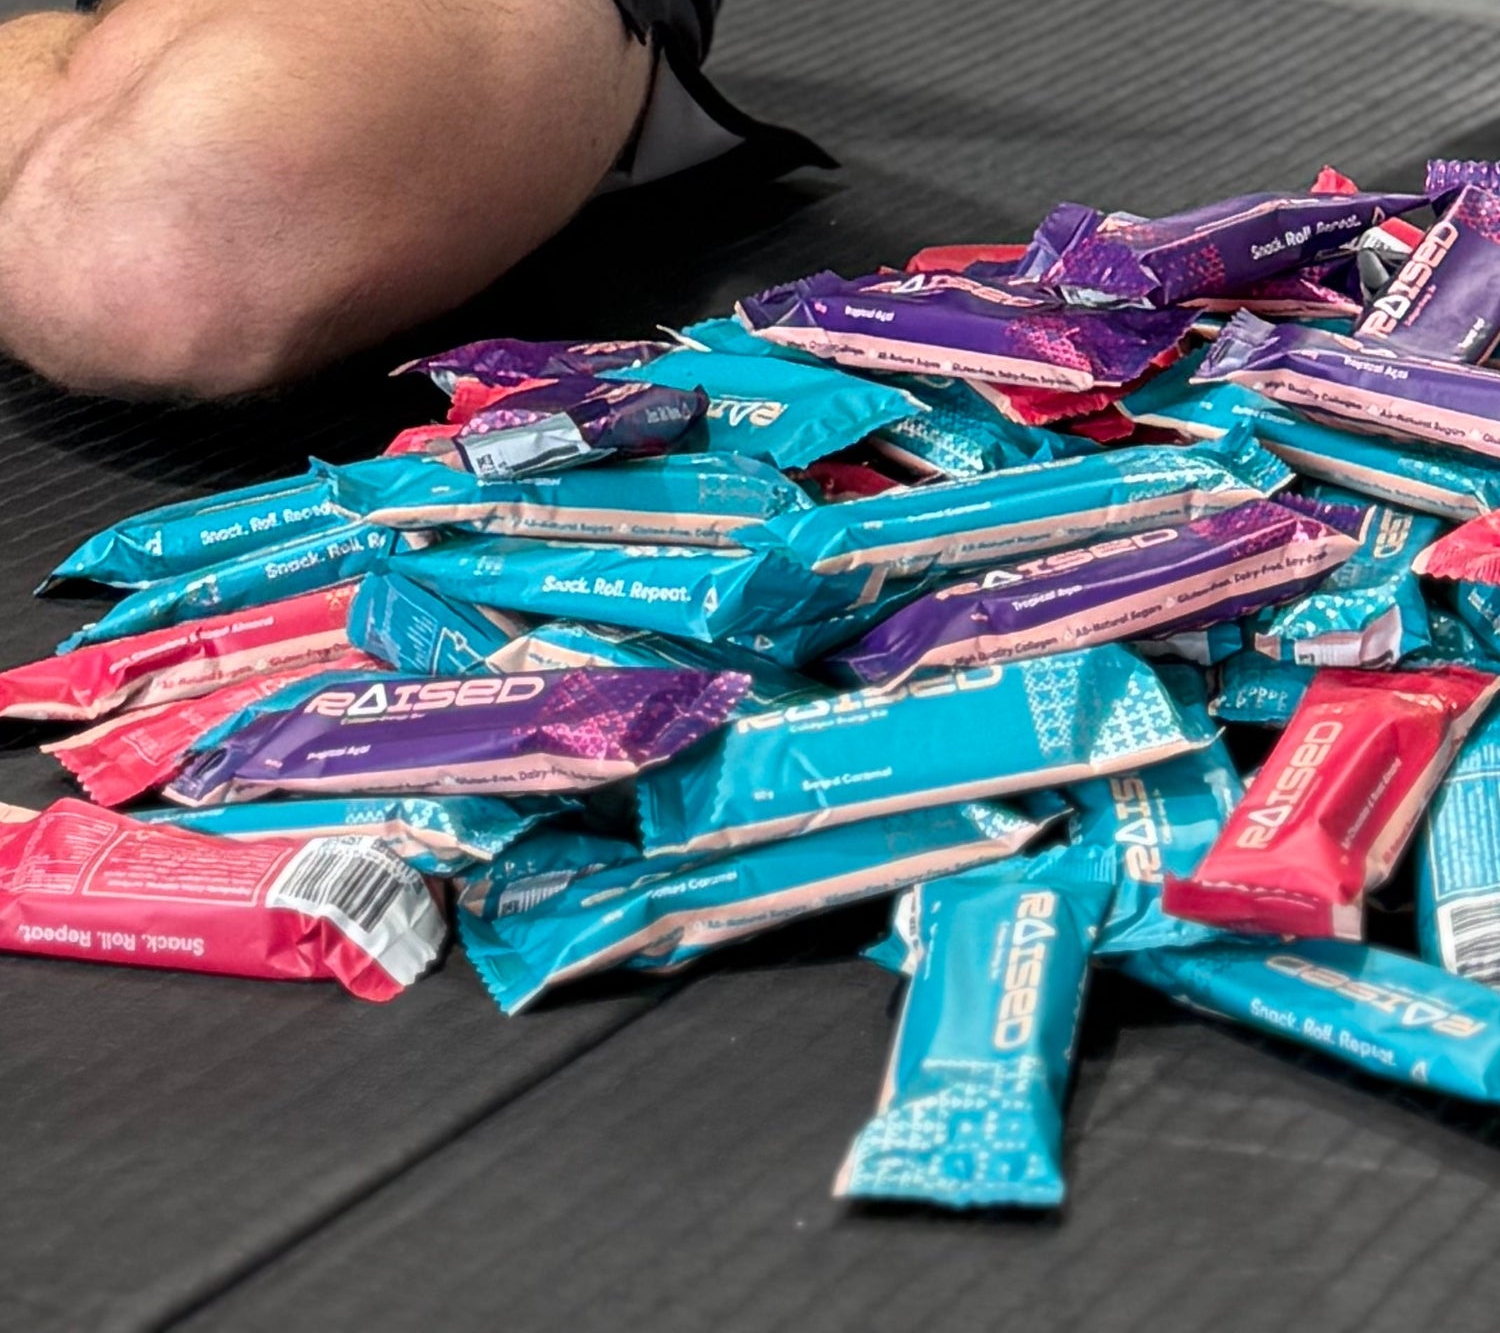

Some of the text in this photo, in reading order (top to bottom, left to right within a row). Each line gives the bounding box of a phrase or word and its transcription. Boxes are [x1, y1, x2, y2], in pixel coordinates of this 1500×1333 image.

[629, 581, 692, 603] Repeat.
[303, 676, 545, 717] RAISED
[1235, 721, 1344, 850] RAISED
[18, 924, 205, 958] Snack. Roll. Repeat.
[993, 890, 1057, 1051] RAISED
[1249, 997, 1300, 1031] Snack.
[1302, 1017, 1336, 1046] Roll.
[1265, 955, 1487, 1039] RAISED
